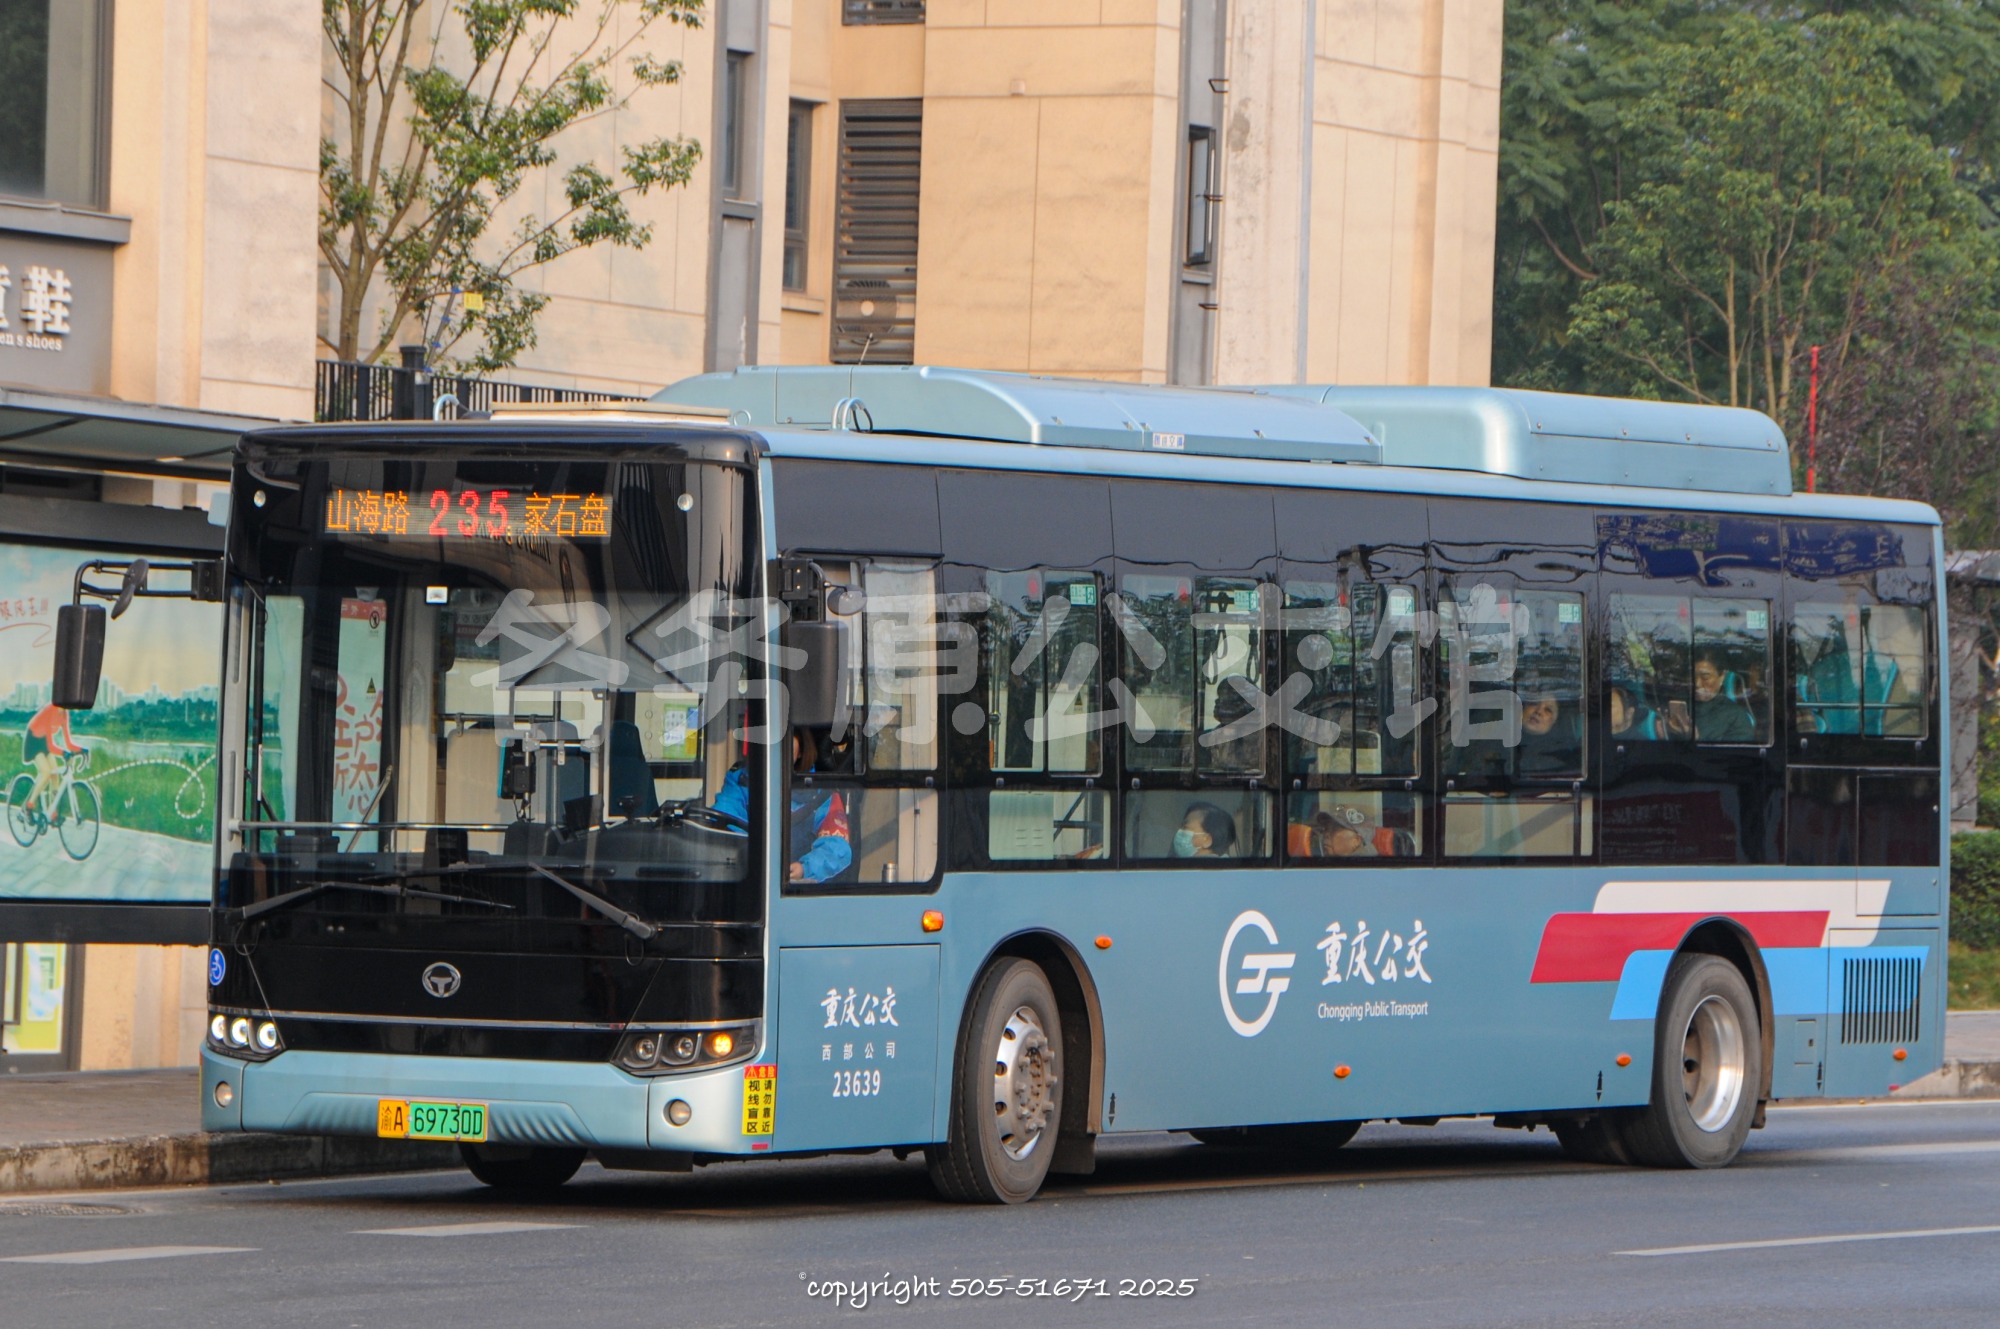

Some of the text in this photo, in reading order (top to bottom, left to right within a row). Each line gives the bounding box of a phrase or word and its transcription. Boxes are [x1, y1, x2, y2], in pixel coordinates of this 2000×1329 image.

[26, 333, 63, 352] shoes
[327, 490, 609, 537] 山海路 235 家石盘
[1316, 919, 1432, 986] 重庆公交
[820, 986, 899, 1029] 重庆公交
[1318, 1000, 1429, 1022] Chongqing Public Transport
[822, 1041, 896, 1061] 西部公司
[832, 1069, 881, 1098] 23639
[746, 1080, 760, 1134] 视线盲区
[761, 1079, 772, 1133] 请勿靠近
